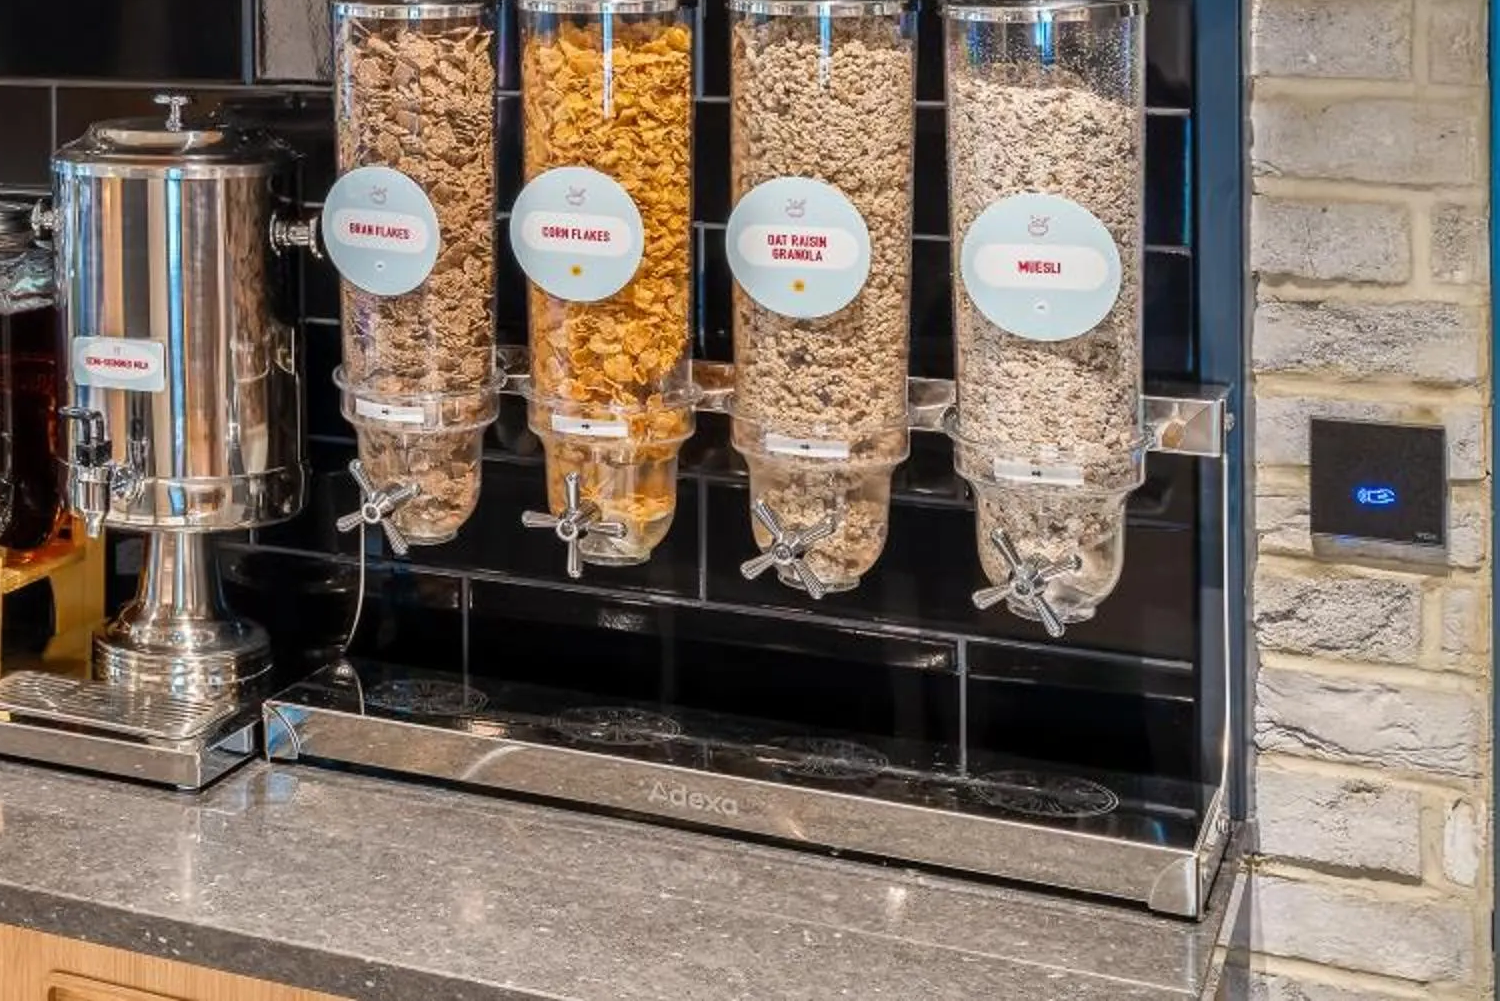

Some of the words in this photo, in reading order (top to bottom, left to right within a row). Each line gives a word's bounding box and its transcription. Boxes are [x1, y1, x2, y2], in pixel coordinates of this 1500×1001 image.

[350, 222, 375, 235] BRAN
[375, 225, 409, 240] FLAKES
[542, 226, 569, 239] CORN
[571, 228, 611, 242] FLAKES
[767, 234, 788, 246] OAT
[791, 234, 827, 248] RAISIN
[772, 248, 823, 262] GRANOLA
[1018, 260, 1061, 274] MUESLI
[647, 781, 738, 816] Adexa
